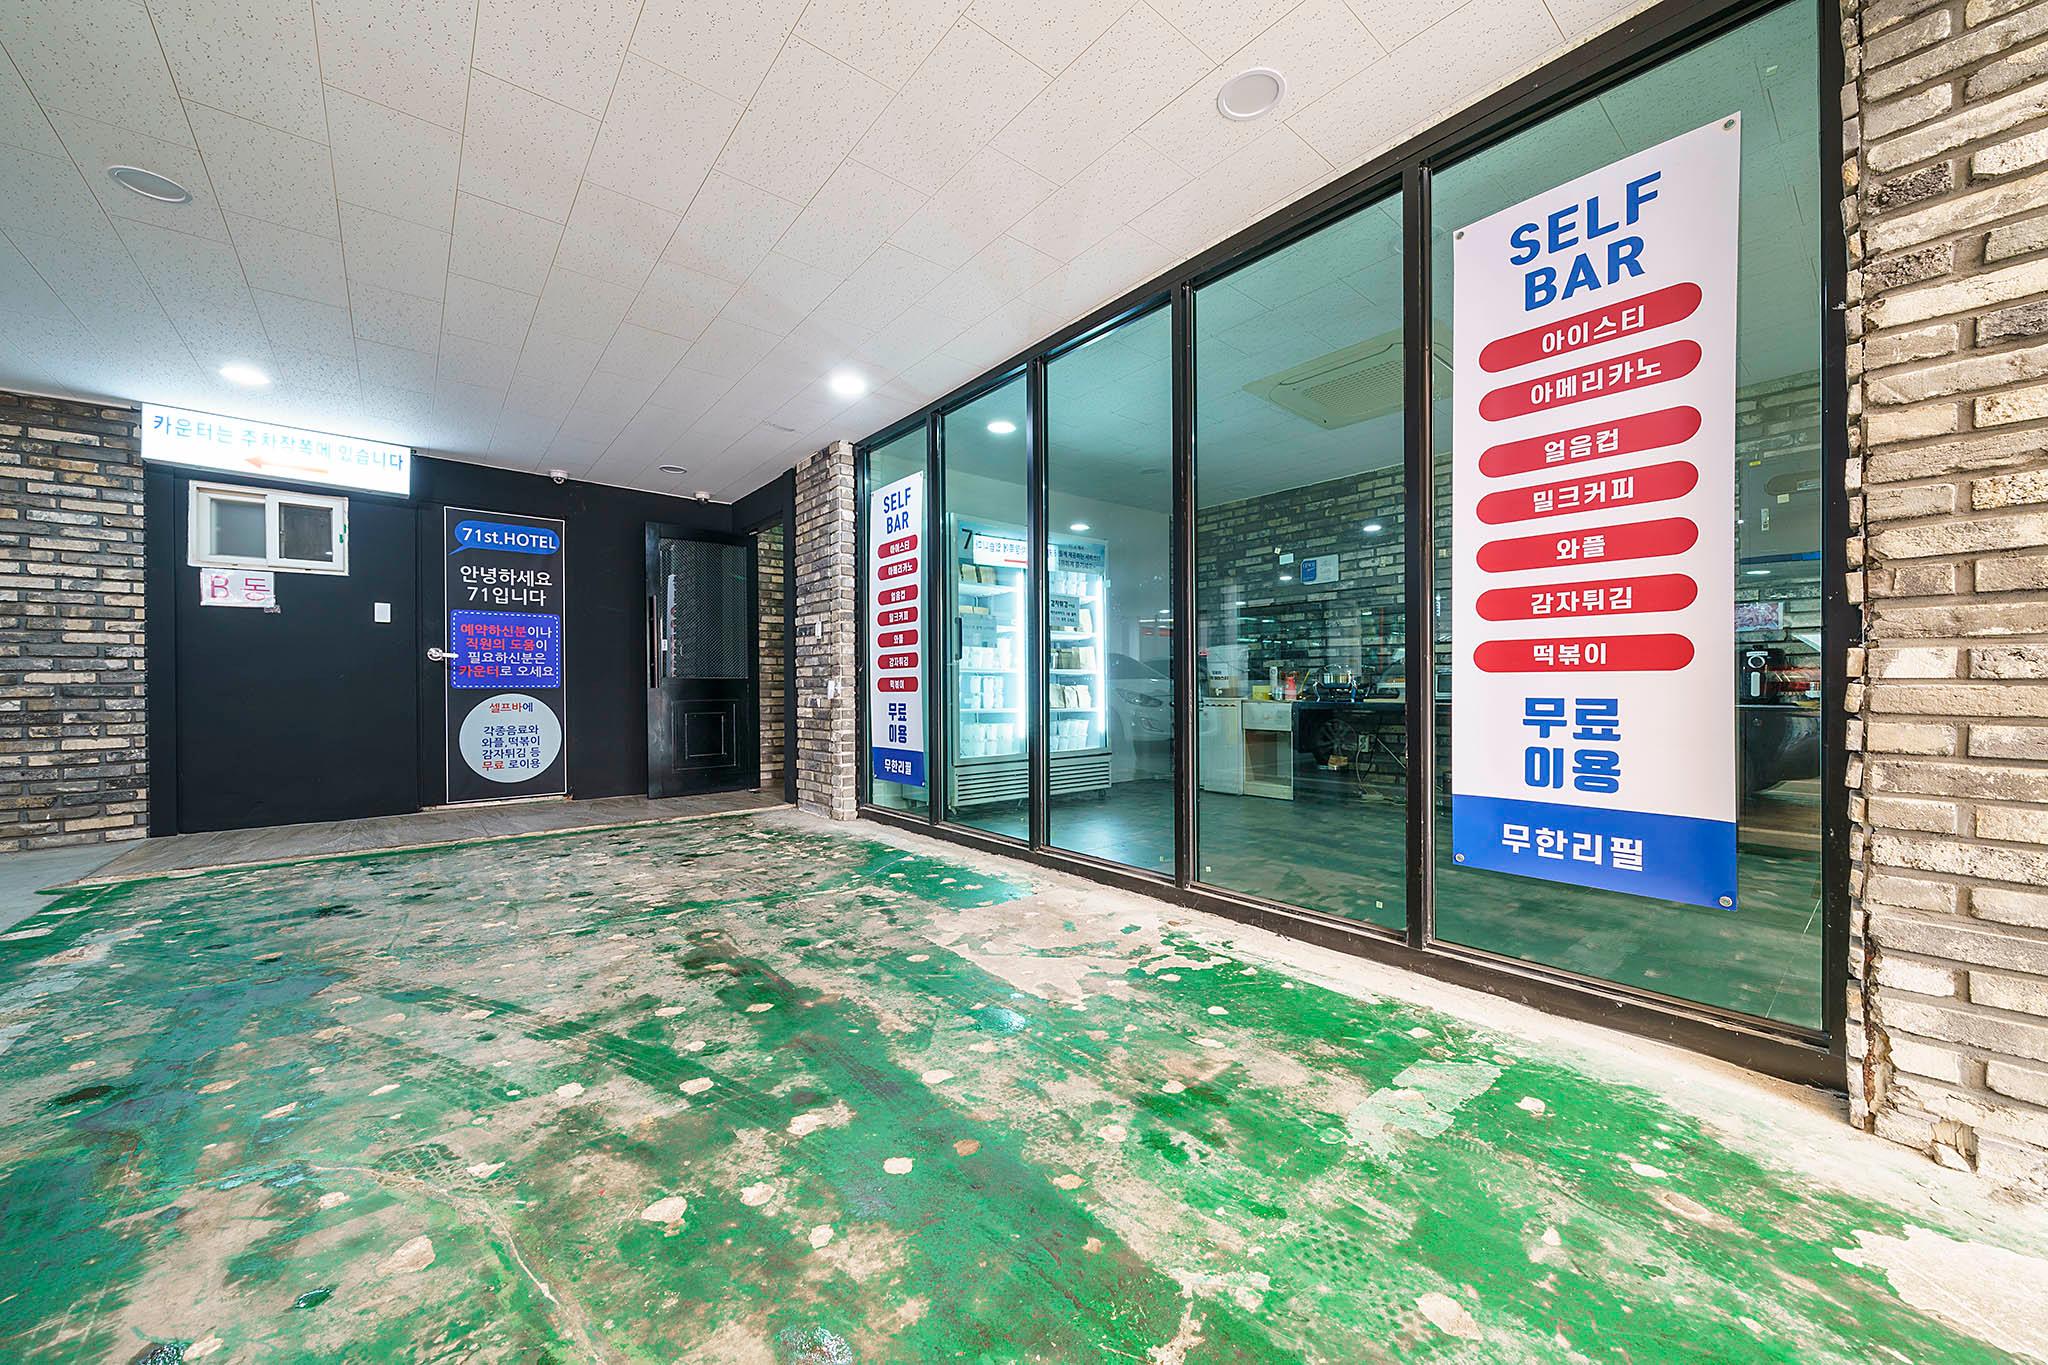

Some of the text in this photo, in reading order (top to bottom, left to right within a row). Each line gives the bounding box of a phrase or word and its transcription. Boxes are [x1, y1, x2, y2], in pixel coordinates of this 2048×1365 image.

[1510, 170, 1661, 266] SELF
[1524, 235, 1646, 312] BAR
[1541, 305, 1646, 353] 아이스티
[1530, 355, 1662, 406] 아메리카노
[153, 415, 404, 471] 카운터는 주차장쪽에 있습니다
[1544, 428, 1620, 463] 얼음컵
[883, 487, 911, 514] SELF
[1533, 476, 1635, 511] 밀크커피
[886, 510, 909, 535] BAR
[462, 527, 557, 550] 71st.HOTEL
[889, 540, 910, 554] 아이스티
[1555, 535, 1606, 561] 와플
[210, 575, 229, 599] B
[460, 565, 552, 587] 안녕하세요
[467, 586, 547, 606] 71입니다
[1530, 586, 1633, 615] 감자튀김
[460, 623, 552, 639] 예약하신분이나
[466, 638, 547, 651] 직원의 도움이
[1532, 643, 1607, 666] 떡볶이
[468, 651, 546, 664] 필요하신분은
[458, 665, 554, 678] 카운터로 오세요
[489, 702, 533, 713] 셀프바에
[888, 703, 907, 721] 무료
[483, 725, 538, 736] 각종음료와
[1522, 697, 1621, 742] 무료
[889, 724, 907, 744] 이용
[482, 748, 526, 760] 감자튀김
[482, 758, 540, 771] 무료 로이용
[884, 758, 912, 776] 무한리필
[1524, 746, 1621, 794] 이용
[1501, 822, 1644, 872] 무한리필
